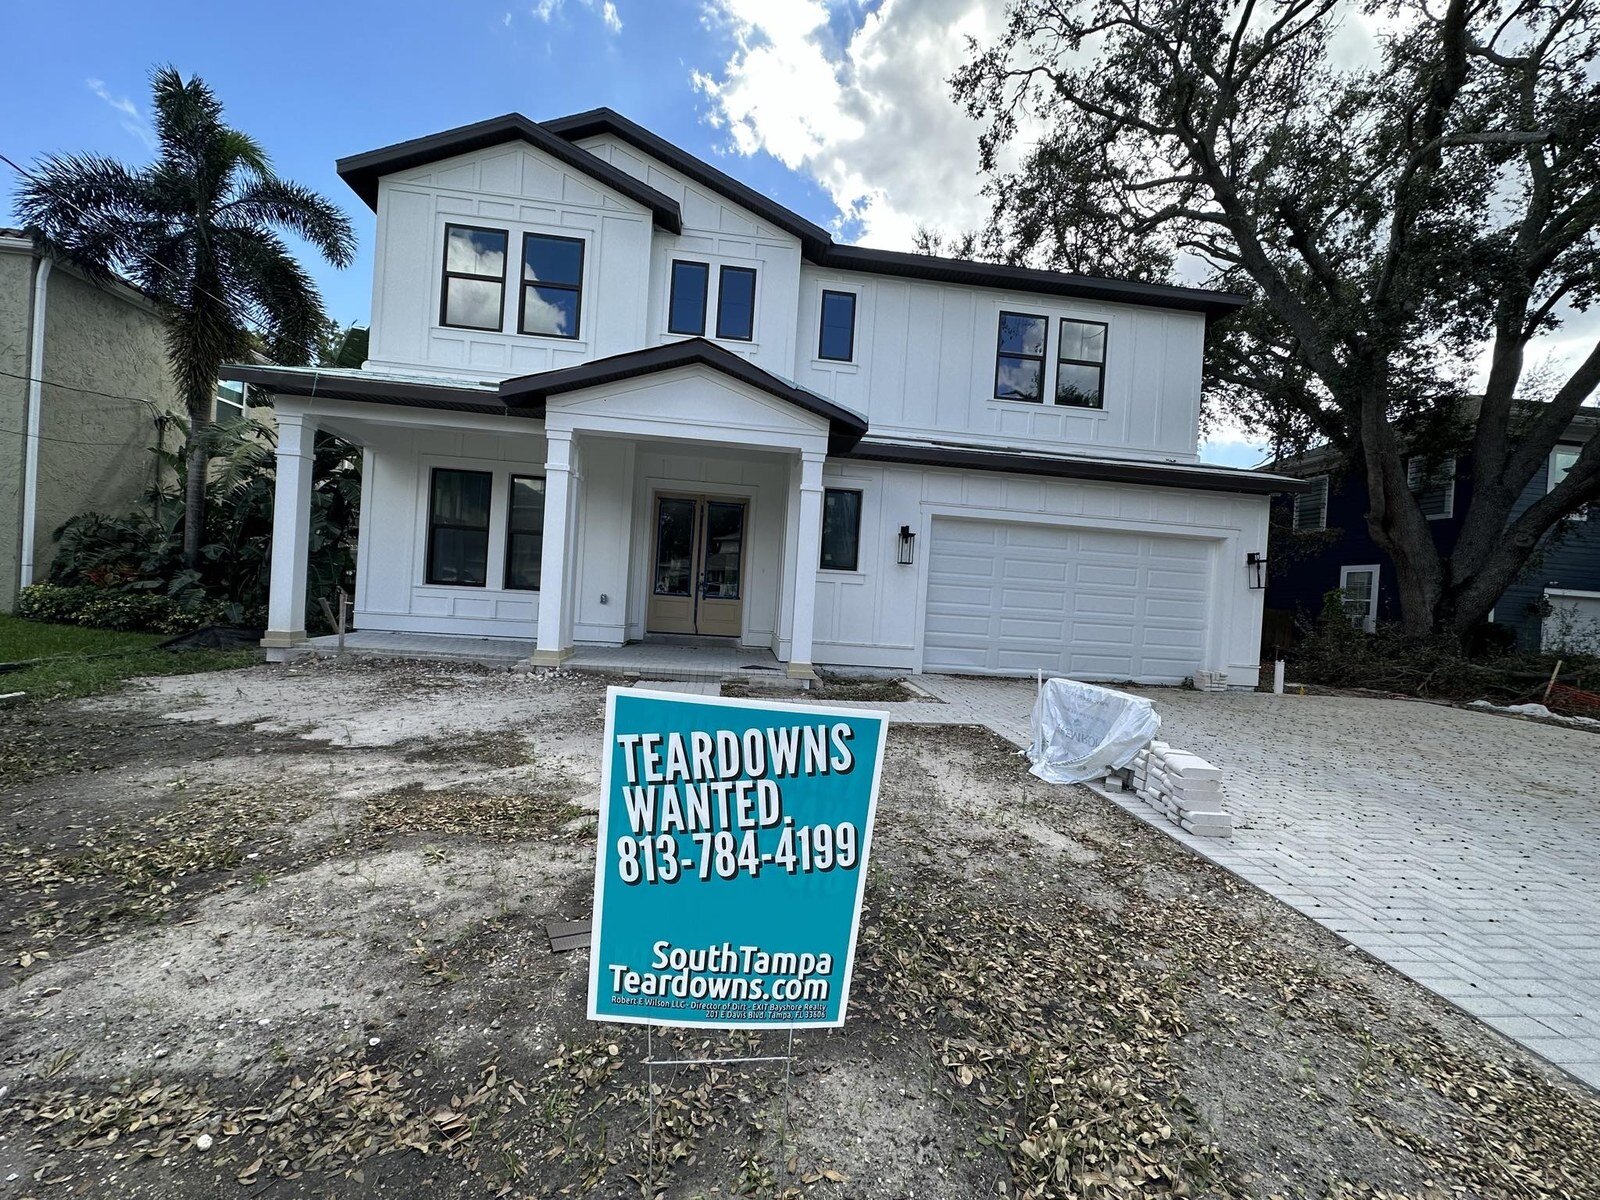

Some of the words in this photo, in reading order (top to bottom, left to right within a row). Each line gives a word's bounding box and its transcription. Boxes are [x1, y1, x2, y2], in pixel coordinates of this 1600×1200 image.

[617, 722, 854, 784] TEARDOWNS
[622, 779, 793, 833] WANTED.
[616, 821, 858, 883] 813-784-4199
[651, 940, 832, 979] SouthTampa
[608, 964, 829, 1000] Teardowns.com
[611, 995, 637, 1005] Robert
[644, 998, 670, 1007] Wilson
[671, 1000, 685, 1008] LLC
[690, 1001, 721, 1011] Director
[722, 1002, 730, 1010] of
[731, 1002, 746, 1011] Dirt
[752, 1003, 768, 1011] EXIT
[770, 1003, 802, 1012] Bayshore
[804, 1003, 827, 1012] Realty
[705, 1010, 718, 1018] 201
[768, 1011, 794, 1020] Tampa,
